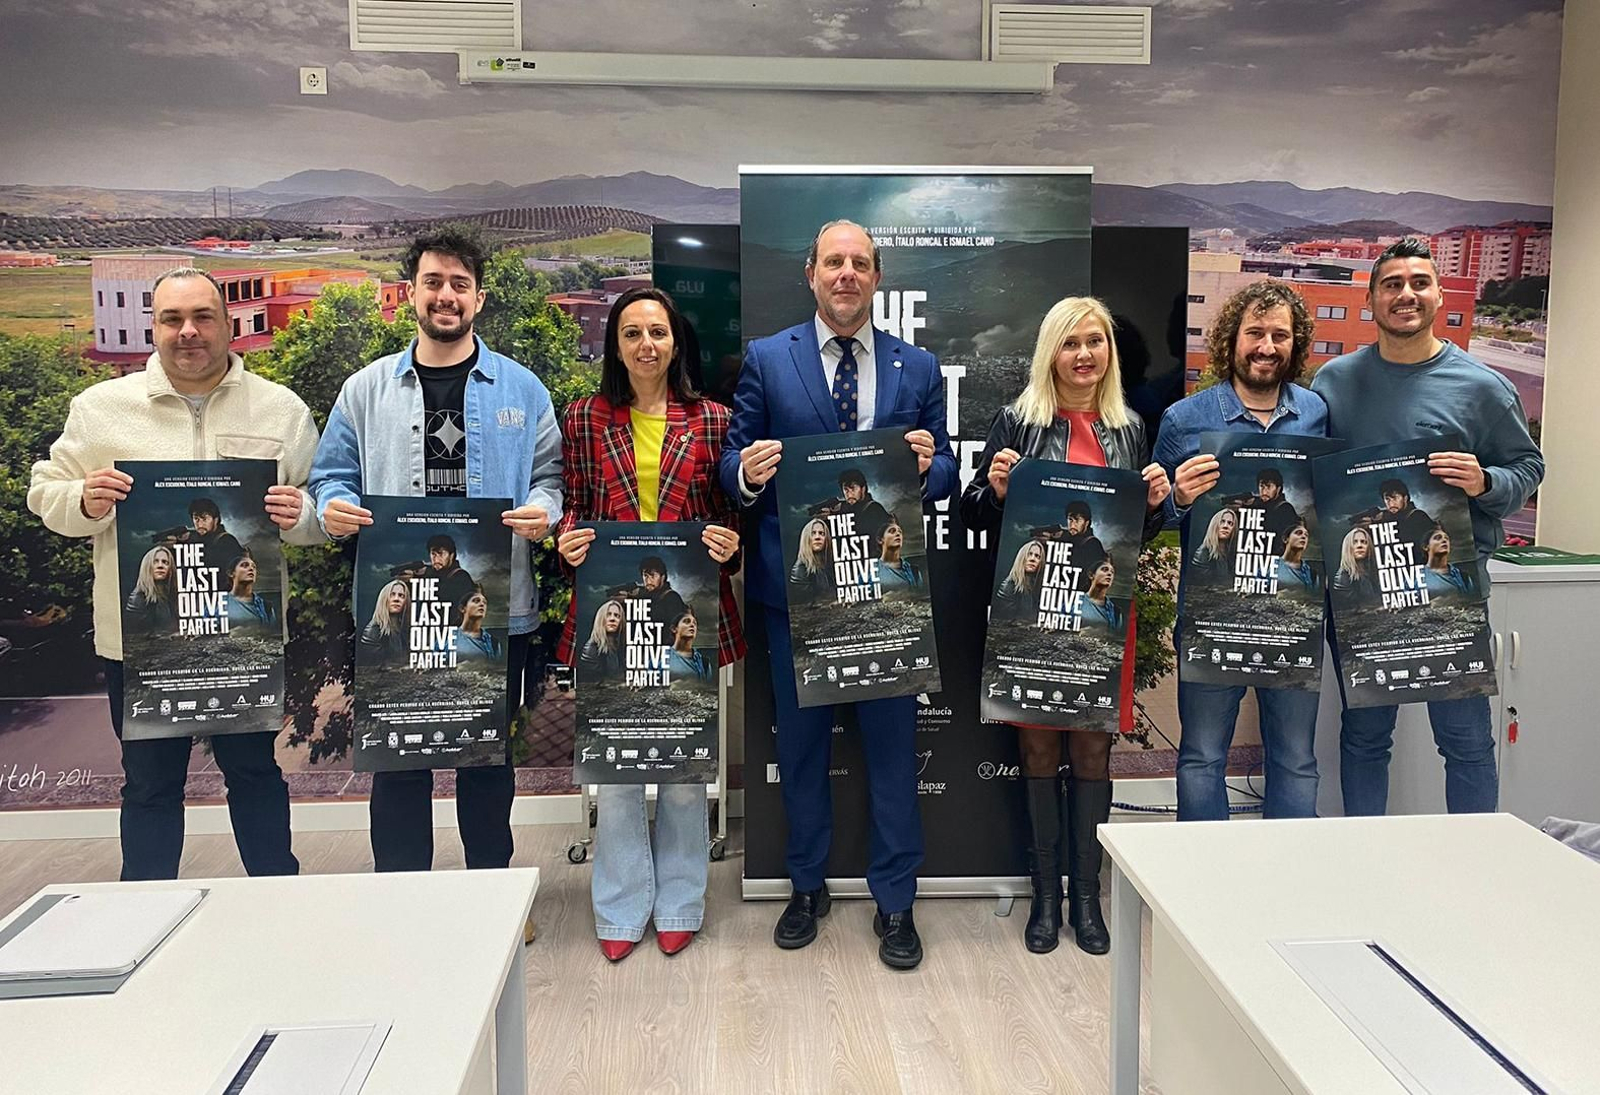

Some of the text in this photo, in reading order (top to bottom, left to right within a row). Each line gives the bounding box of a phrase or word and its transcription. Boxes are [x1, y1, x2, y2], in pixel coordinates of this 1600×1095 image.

[896, 235, 915, 246] ÍTALO
[915, 236, 942, 247] RONCAL
[943, 236, 949, 246] E
[949, 236, 975, 247] ISMAEL
[975, 236, 995, 246] CANO
[900, 226, 926, 234] ESCRITA
[873, 290, 927, 351] HE
[827, 513, 856, 537] THE
[1238, 508, 1265, 530] THE
[1236, 530, 1276, 554] LAST
[1368, 521, 1400, 546] THE
[173, 543, 205, 567] THE
[831, 535, 870, 562] LAST
[1046, 540, 1073, 565] THE
[1374, 542, 1415, 569] LAST
[834, 558, 881, 586] OLIVE
[1042, 563, 1083, 590] LAST
[1235, 553, 1280, 578] OLIVE
[176, 567, 220, 592] LAST
[409, 578, 439, 601] THE
[1233, 576, 1278, 595] PARTE II
[1378, 564, 1427, 593] OLIVE
[178, 591, 229, 617] OLIVE
[837, 583, 882, 604] PARTE II
[1039, 587, 1085, 614] OLIVE
[1381, 588, 1430, 610] PARTE II
[410, 602, 452, 626] LAST
[624, 598, 652, 621] THE
[1037, 611, 1081, 632] PARTE II
[179, 616, 230, 636] PARTE II
[626, 622, 664, 645] LAST
[409, 626, 458, 651] OLIVE
[409, 651, 457, 669] PARTE II
[625, 645, 671, 669] OLIVE
[625, 669, 670, 687] PARTE II
[917, 706, 953, 715] ndalucía
[57, 768, 92, 786] 2011
